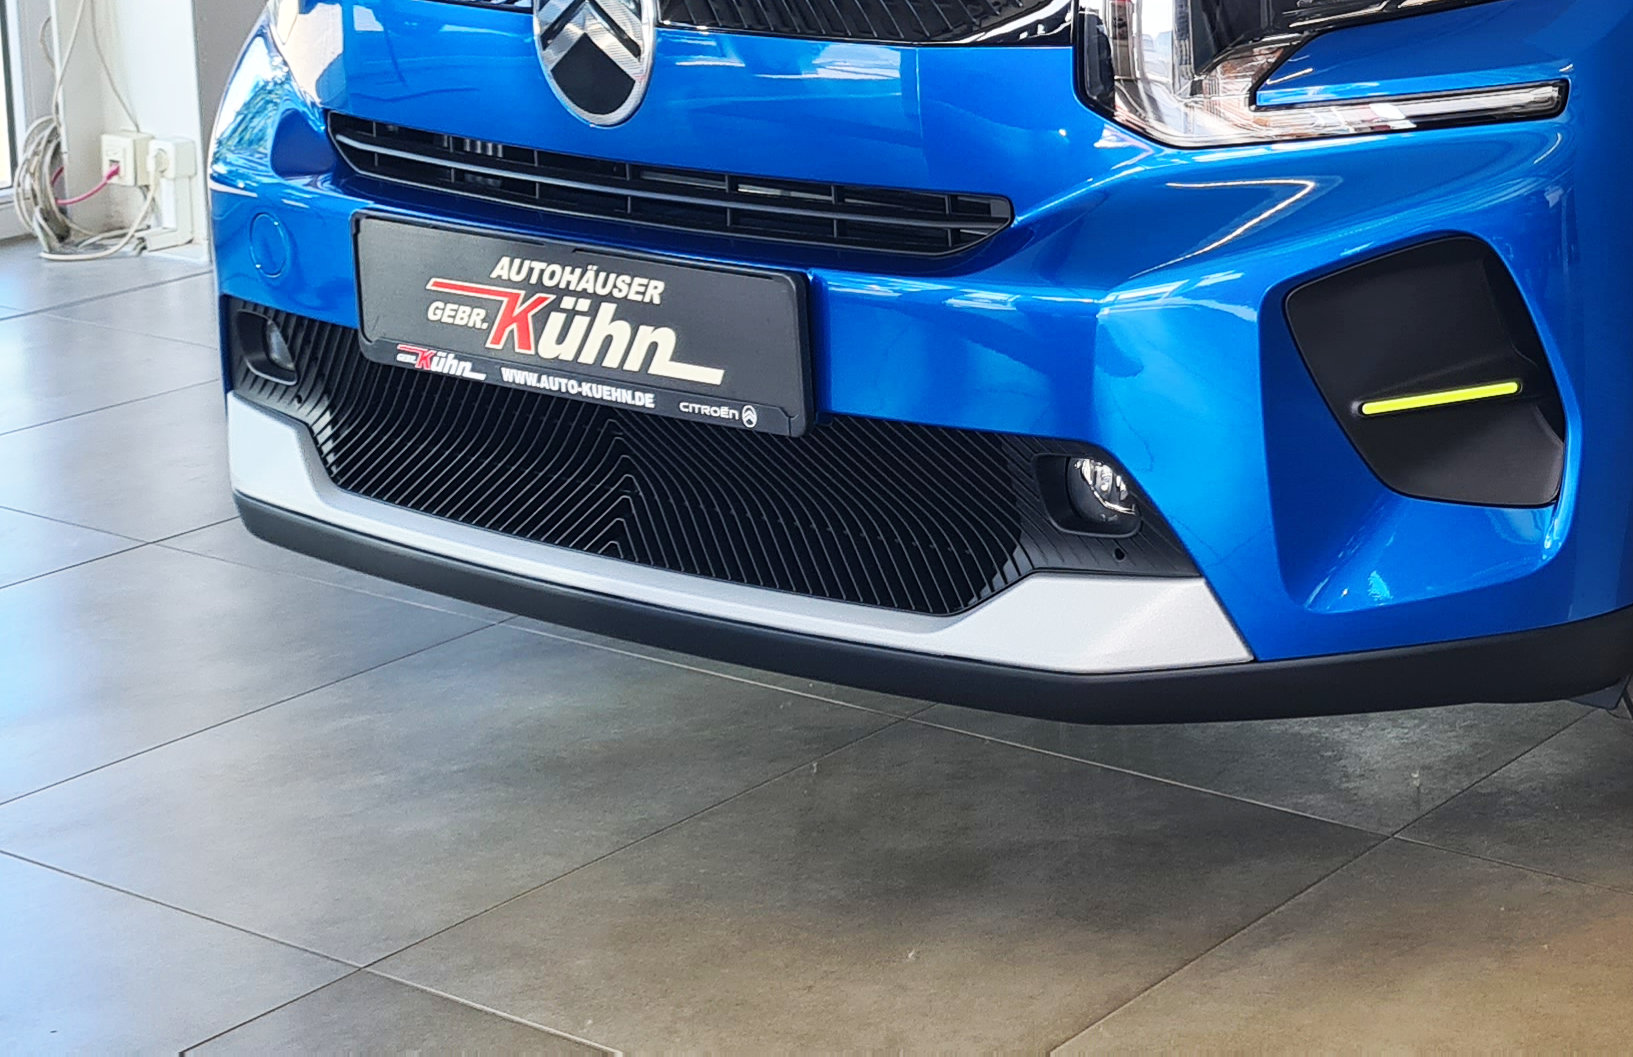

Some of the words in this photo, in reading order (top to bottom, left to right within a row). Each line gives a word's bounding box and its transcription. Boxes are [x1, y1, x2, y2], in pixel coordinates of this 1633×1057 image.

[489, 255, 666, 306] AUTOHÄUSER
[425, 299, 489, 331] GEBR.
[485, 286, 726, 386] Kühn
[414, 349, 487, 381] Kühn
[500, 366, 656, 410] WWW.AUTO-KUEHN.DE
[678, 400, 740, 422] CITROËN
